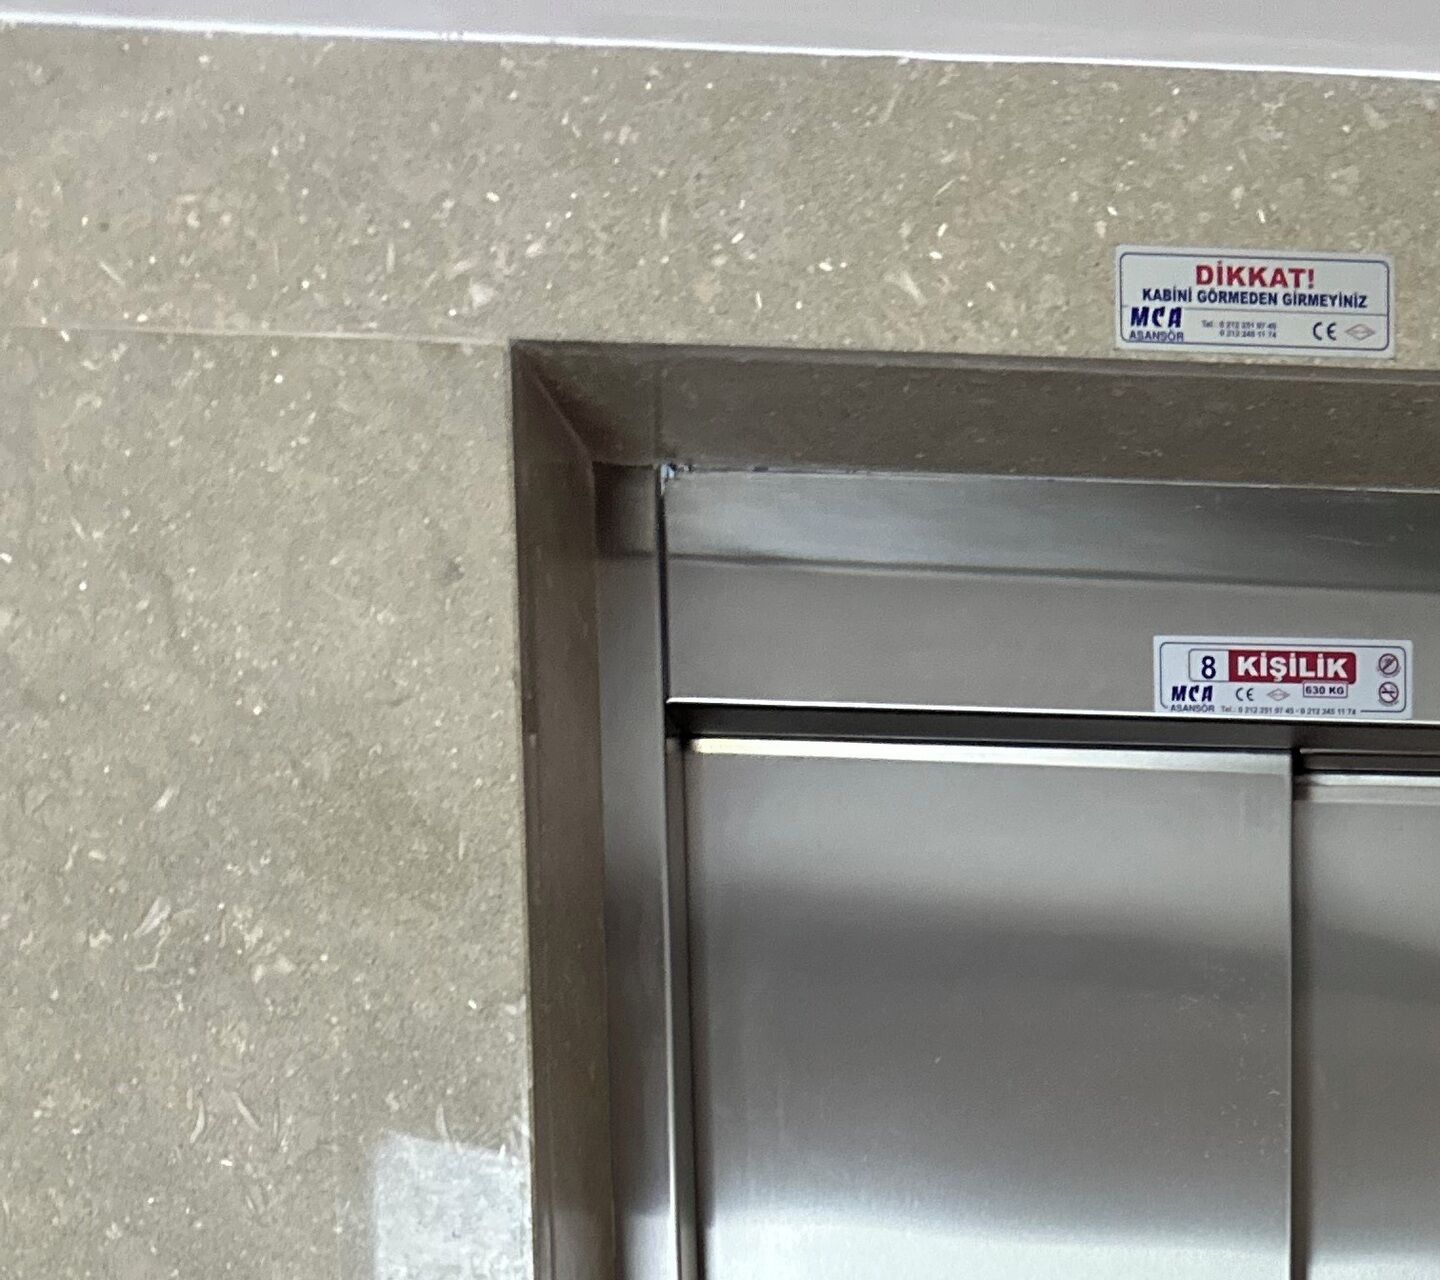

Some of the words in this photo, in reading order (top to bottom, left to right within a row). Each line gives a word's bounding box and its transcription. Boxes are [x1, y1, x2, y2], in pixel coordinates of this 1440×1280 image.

[1195, 259, 1315, 289] DİKKAT!
[1142, 286, 1193, 303] KABİNİ
[1196, 287, 1278, 306] GÖRMEDEN
[1282, 291, 1368, 309] GİRMEYİNİZ
[1130, 306, 1183, 328] MCA
[1128, 328, 1185, 343] ASANSÖR
[1201, 655, 1217, 679] 8
[1237, 651, 1349, 682] KİŞİLİK
[1171, 685, 1214, 702] MCA
[1305, 685, 1326, 695] 630
[1329, 686, 1345, 696] KG
[1170, 702, 1215, 713] ASANSÖR
